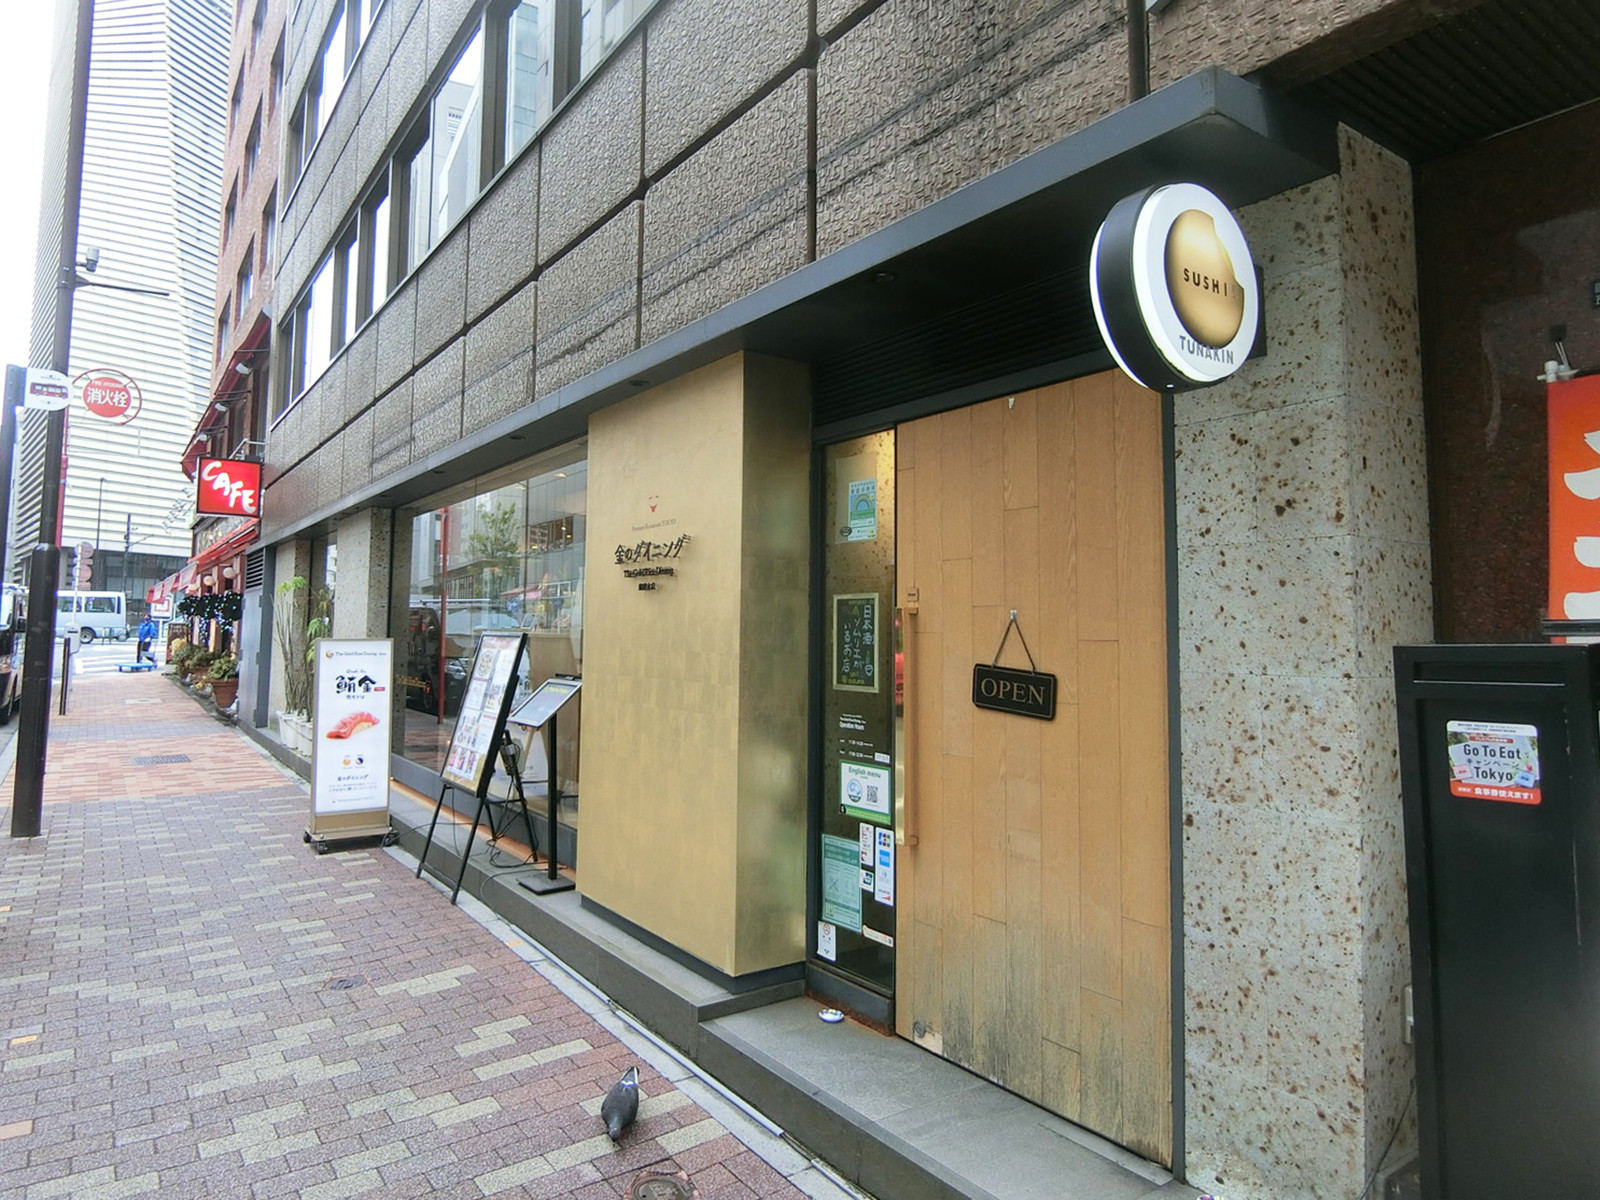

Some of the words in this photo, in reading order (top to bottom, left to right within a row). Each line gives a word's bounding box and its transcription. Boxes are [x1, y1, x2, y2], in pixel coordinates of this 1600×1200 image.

[1183, 268, 1228, 296] SUSHI
[1179, 335, 1234, 364] TUNAKIN
[86, 386, 128, 407] 消火栓
[201, 461, 256, 513] CAFE
[981, 678, 1045, 705] OPEN
[1463, 744, 1479, 756] Go
[1482, 745, 1496, 757] To
[1499, 746, 1521, 760] Eat
[848, 766, 866, 775] English
[1467, 758, 1520, 770] キャンペーン
[1474, 766, 1513, 783] Tokyo
